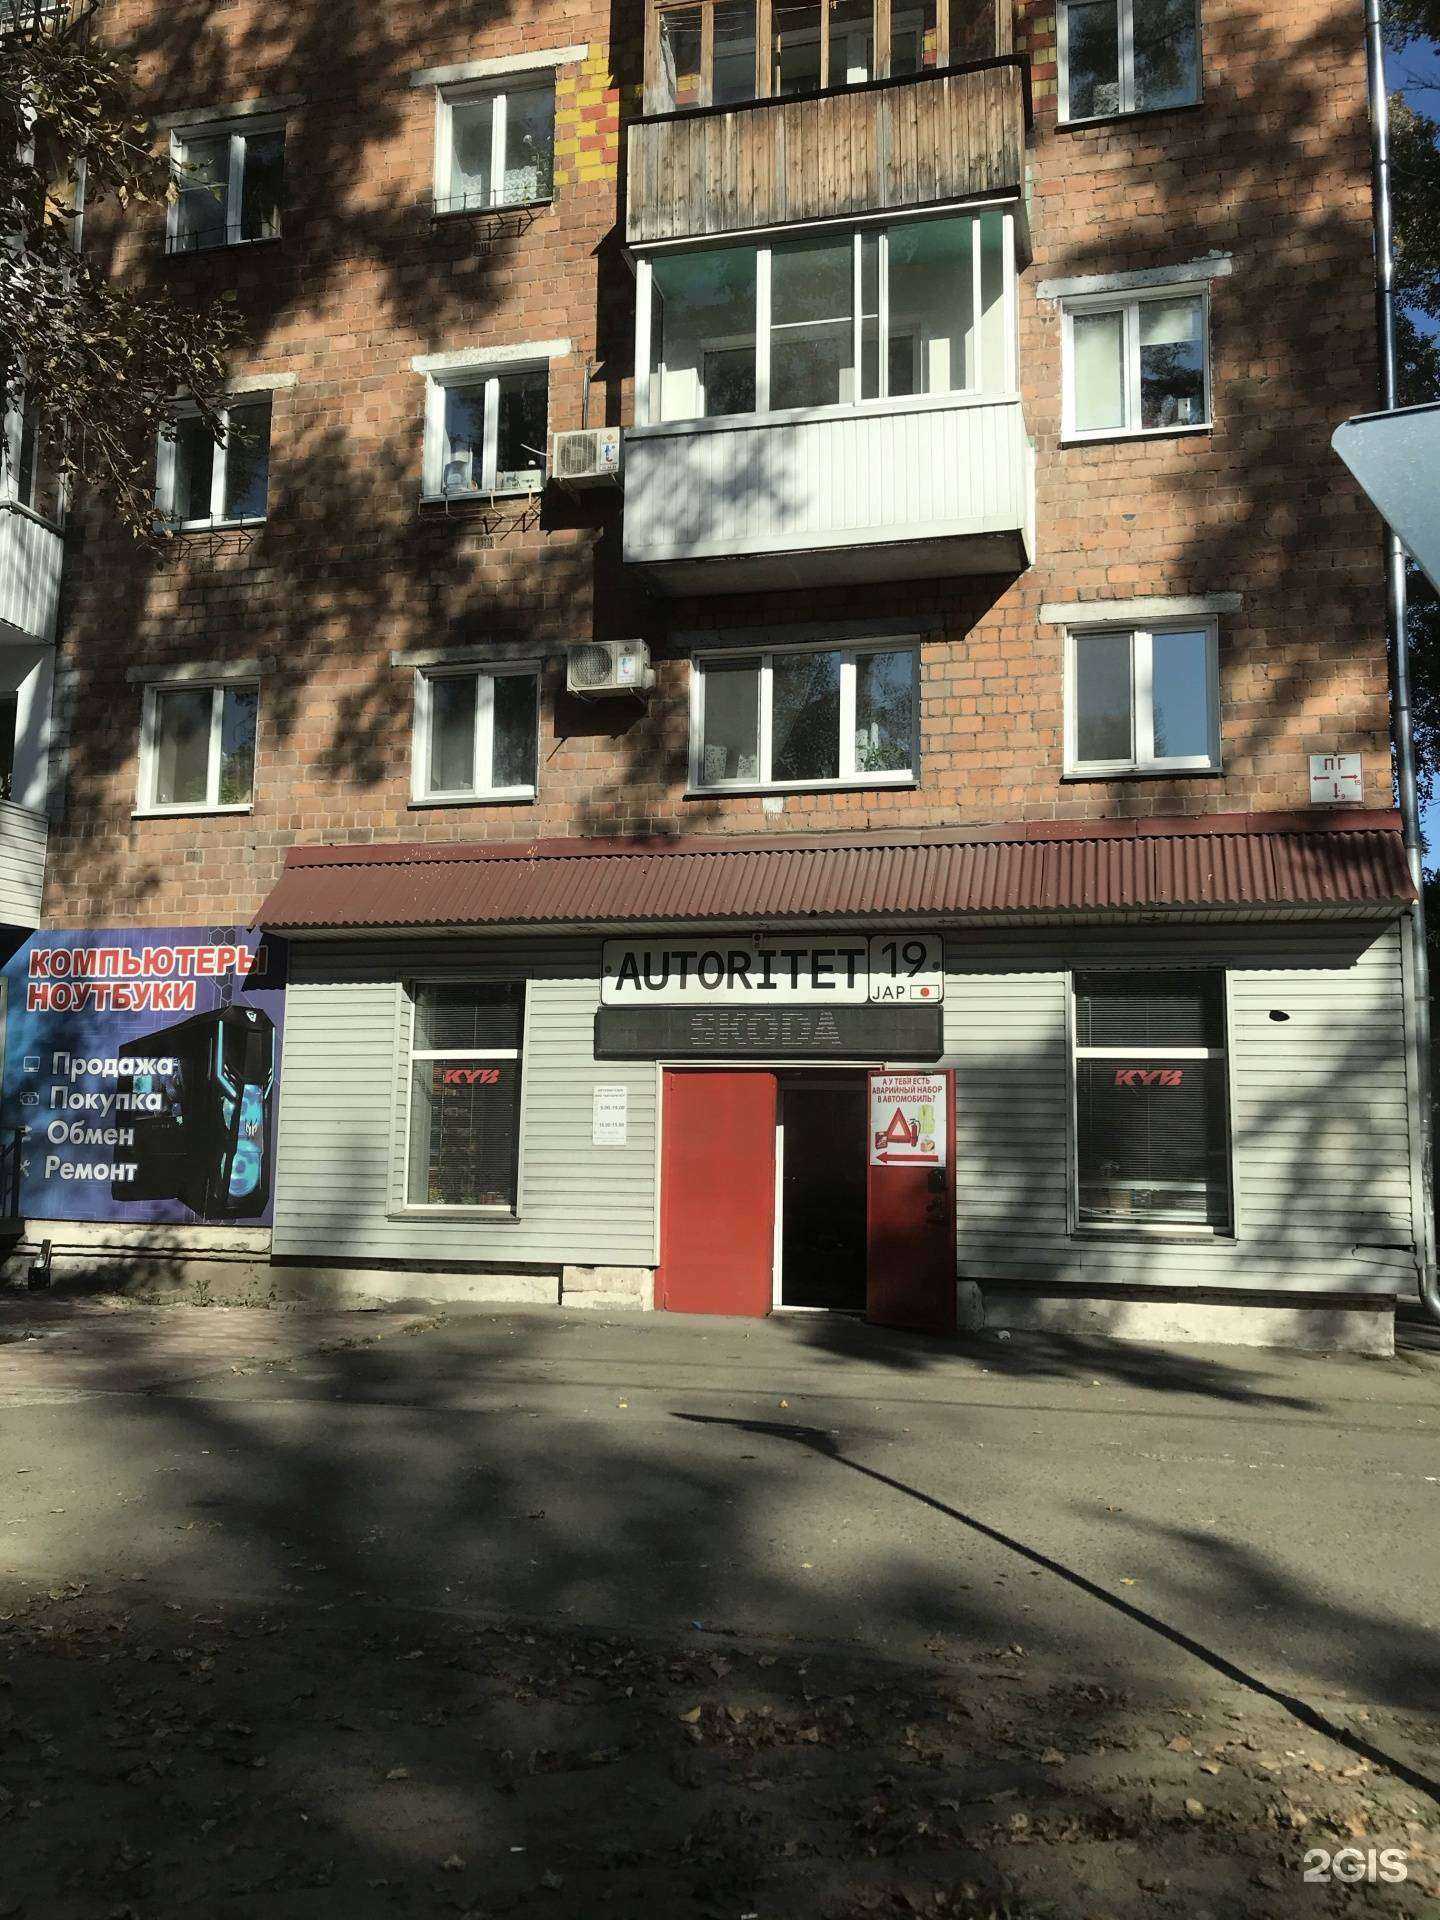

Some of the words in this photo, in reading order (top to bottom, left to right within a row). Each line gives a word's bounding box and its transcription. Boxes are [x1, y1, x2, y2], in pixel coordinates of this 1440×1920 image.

[29, 945, 268, 977] КОМПЬЮТЕРЫ
[615, 948, 866, 991] AUTORITET
[881, 941, 928, 979] 19
[27, 980, 196, 1012] НОУТБУКИ
[872, 985, 906, 1000] JAP
[52, 1051, 174, 1082] Продажа
[443, 1068, 501, 1084] KYB
[1113, 1069, 1185, 1086] KYB
[50, 1086, 163, 1117] Покупка
[872, 1085, 916, 1095] АВАРИЙНЫЙ
[917, 1085, 943, 1093] НАБОР
[883, 1095, 935, 1103] АВТОМОБИЛЬ?
[47, 1120, 134, 1146] Обмен
[44, 1155, 138, 1181] Ремонт
